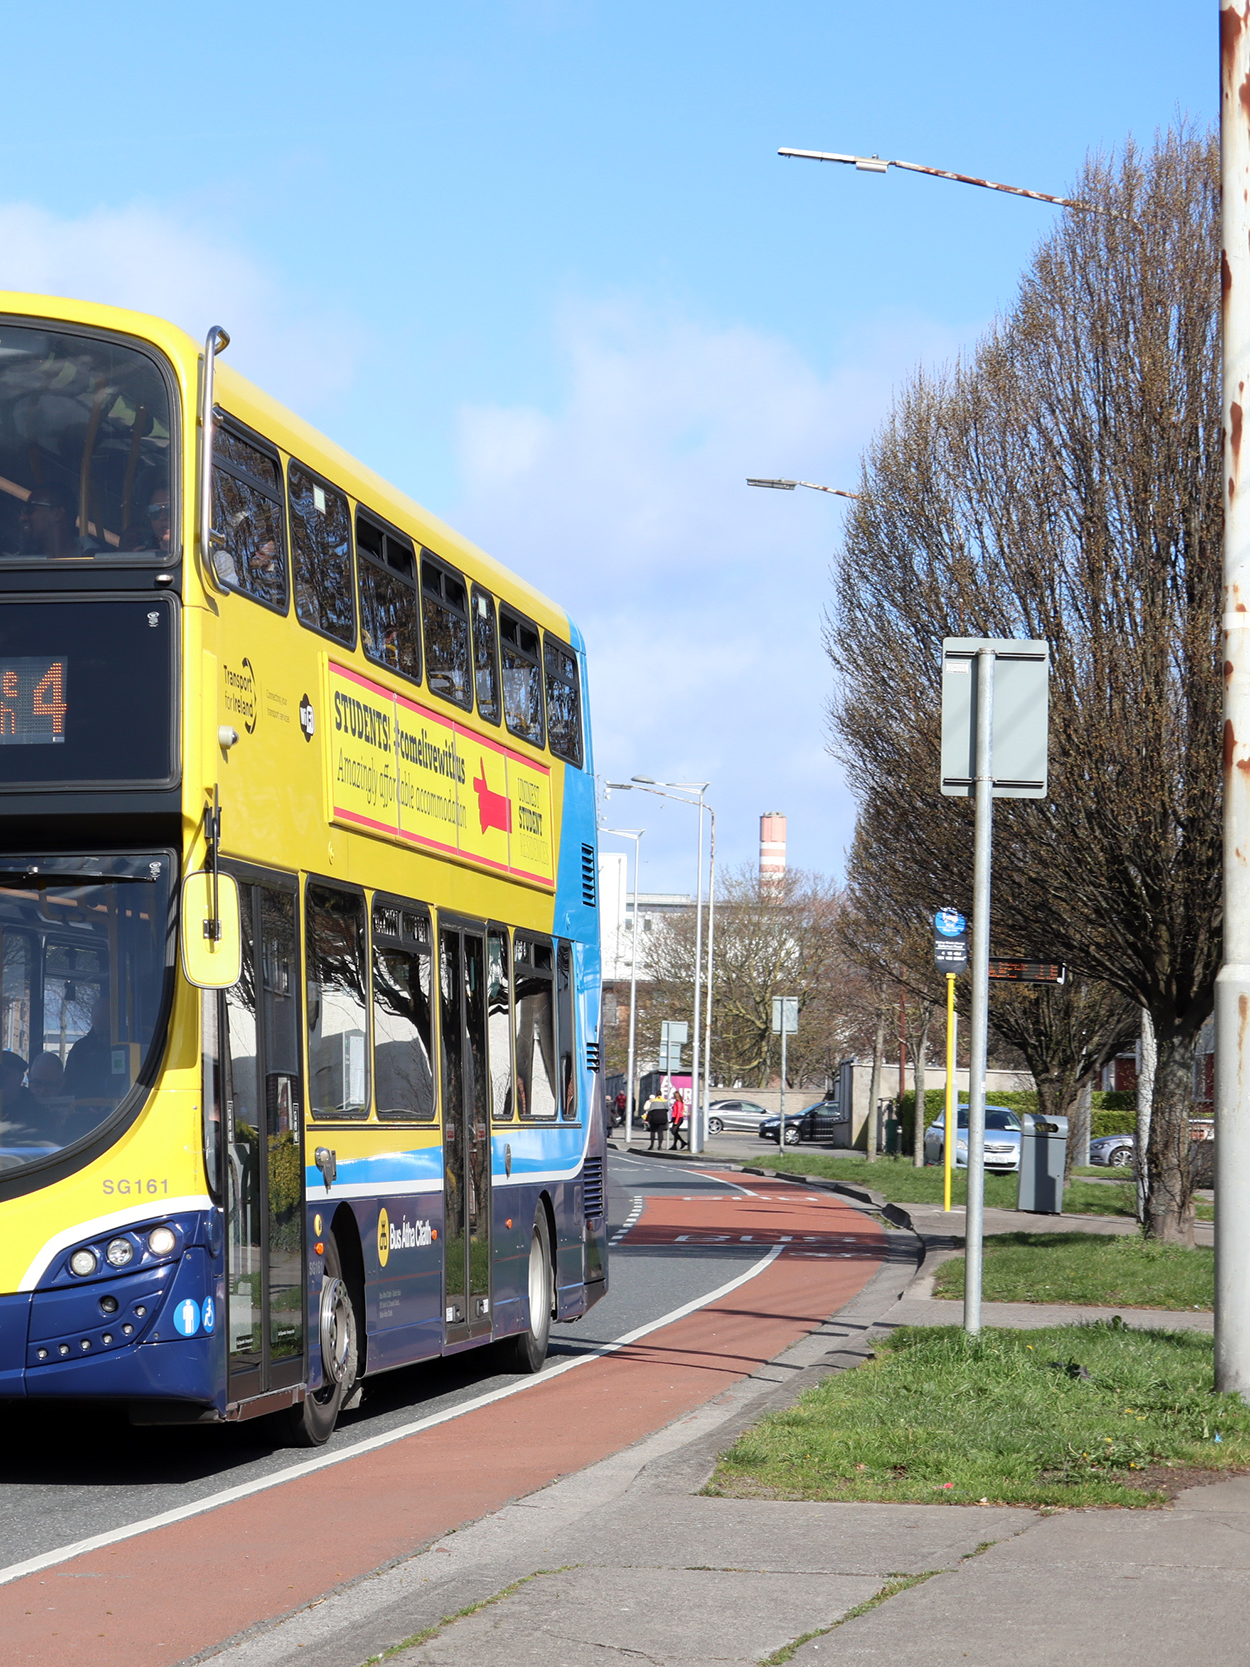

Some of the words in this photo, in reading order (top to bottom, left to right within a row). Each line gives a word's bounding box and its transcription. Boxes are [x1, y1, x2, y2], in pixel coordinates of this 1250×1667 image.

[223, 664, 253, 693] Transport
[33, 663, 68, 734] 4
[334, 690, 392, 754] STUDENTS!
[337, 747, 379, 807] Amazingly
[518, 805, 543, 837] STUDENT
[102, 1179, 168, 1195] SG161
[390, 1223, 401, 1250] Bus
